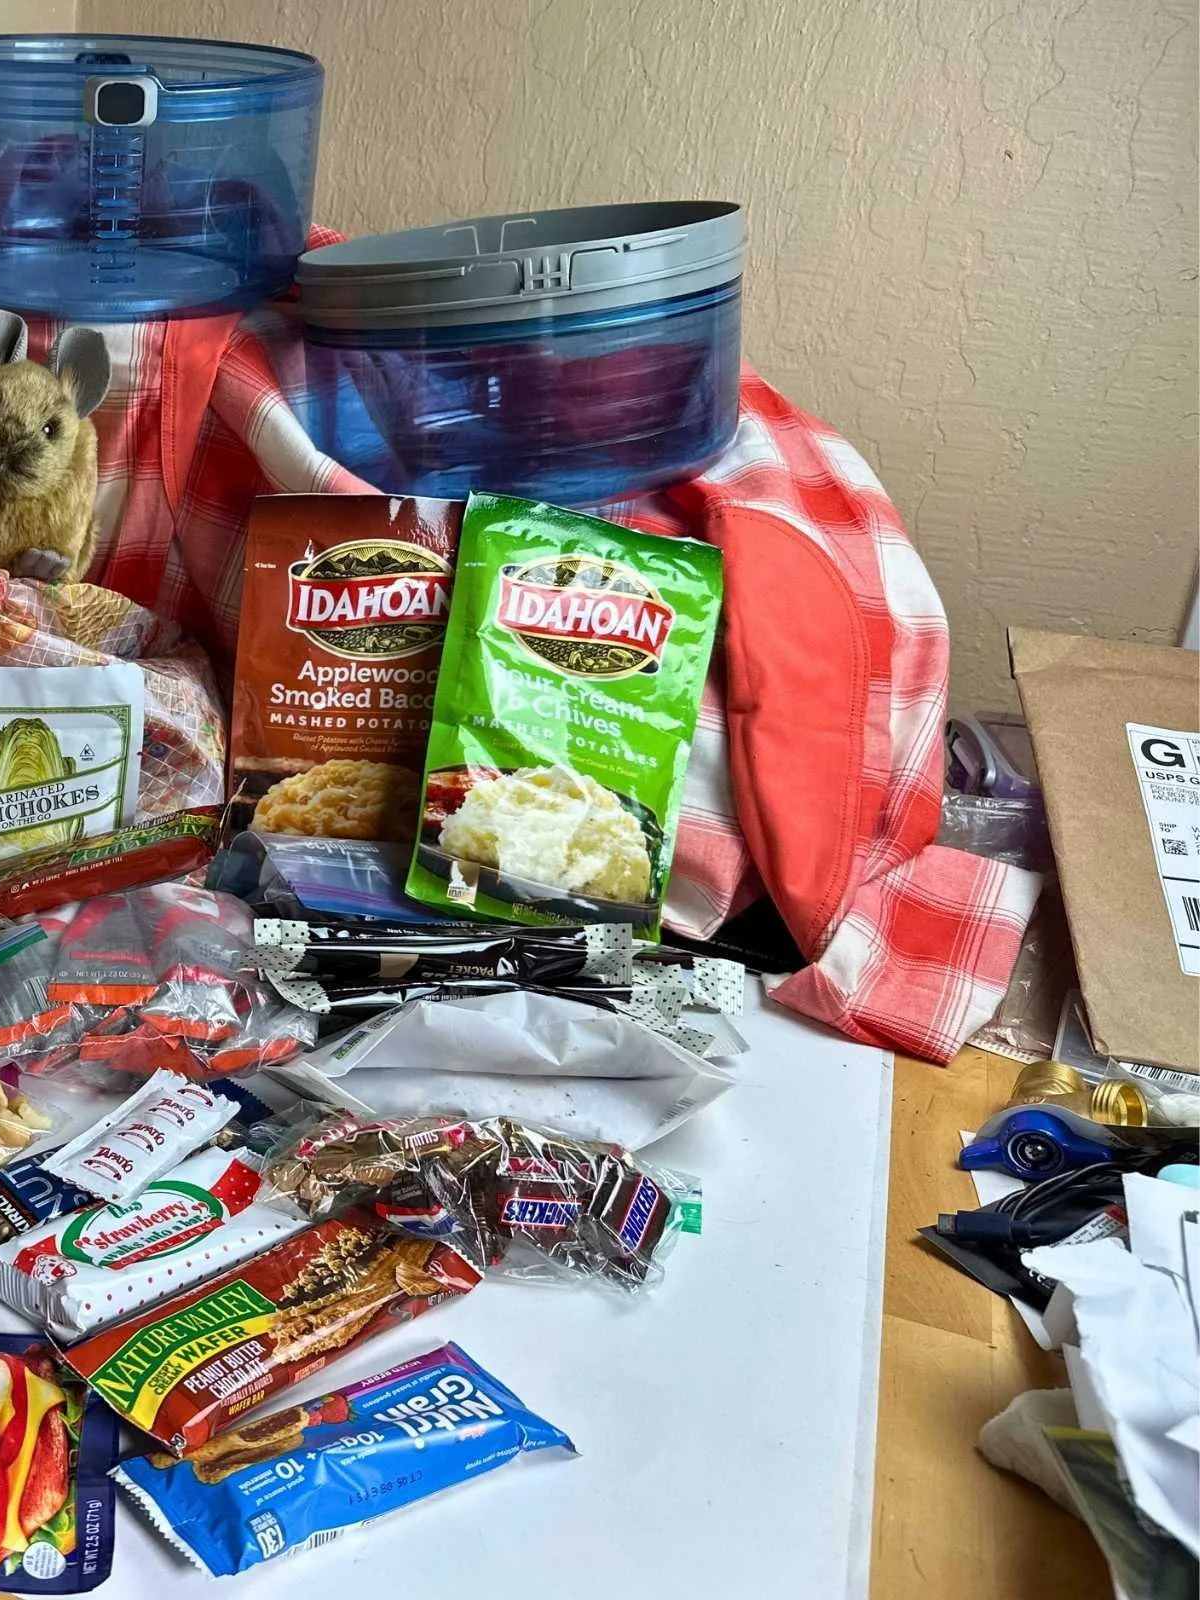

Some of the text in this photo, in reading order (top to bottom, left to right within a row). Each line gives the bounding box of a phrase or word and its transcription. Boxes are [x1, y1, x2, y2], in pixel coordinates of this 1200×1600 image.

[296, 578, 449, 622] IDAHOAN
[506, 586, 665, 647] IDAHOAN
[270, 683, 434, 710] Smoked Baco
[561, 680, 646, 722] Cream
[270, 713, 429, 731] MASHED POTATO
[533, 695, 622, 738] Chives
[564, 733, 658, 768] POTATOES
[1140, 738, 1186, 768] G
[1145, 771, 1186, 784] USPS
[1, 813, 52, 830] ON THE GO
[446, 963, 495, 977] PACKET
[503, 1200, 579, 1227] NICKERS
[103, 1240, 145, 1262] walks
[141, 1229, 173, 1244] into
[96, 1286, 265, 1409] NATURE VALLEY
[175, 1325, 250, 1364] WAFER
[148, 1360, 176, 1388] CRISPY
[153, 1365, 186, 1396] CREAMY
[183, 1340, 267, 1394] PEANUT BUTTER
[209, 1357, 271, 1399] CHOCOLATE
[361, 1370, 392, 1388] BERRY
[228, 1390, 265, 1416] WAFER BAR
[373, 1374, 474, 1422] Grain
[393, 1389, 504, 1449] Nutri
[275, 1458, 305, 1480] 10
[85, 1522, 100, 1534] OZ
[255, 1523, 286, 1560] 130
[82, 1562, 98, 1575] NET
[84, 1548, 99, 1562] WT
